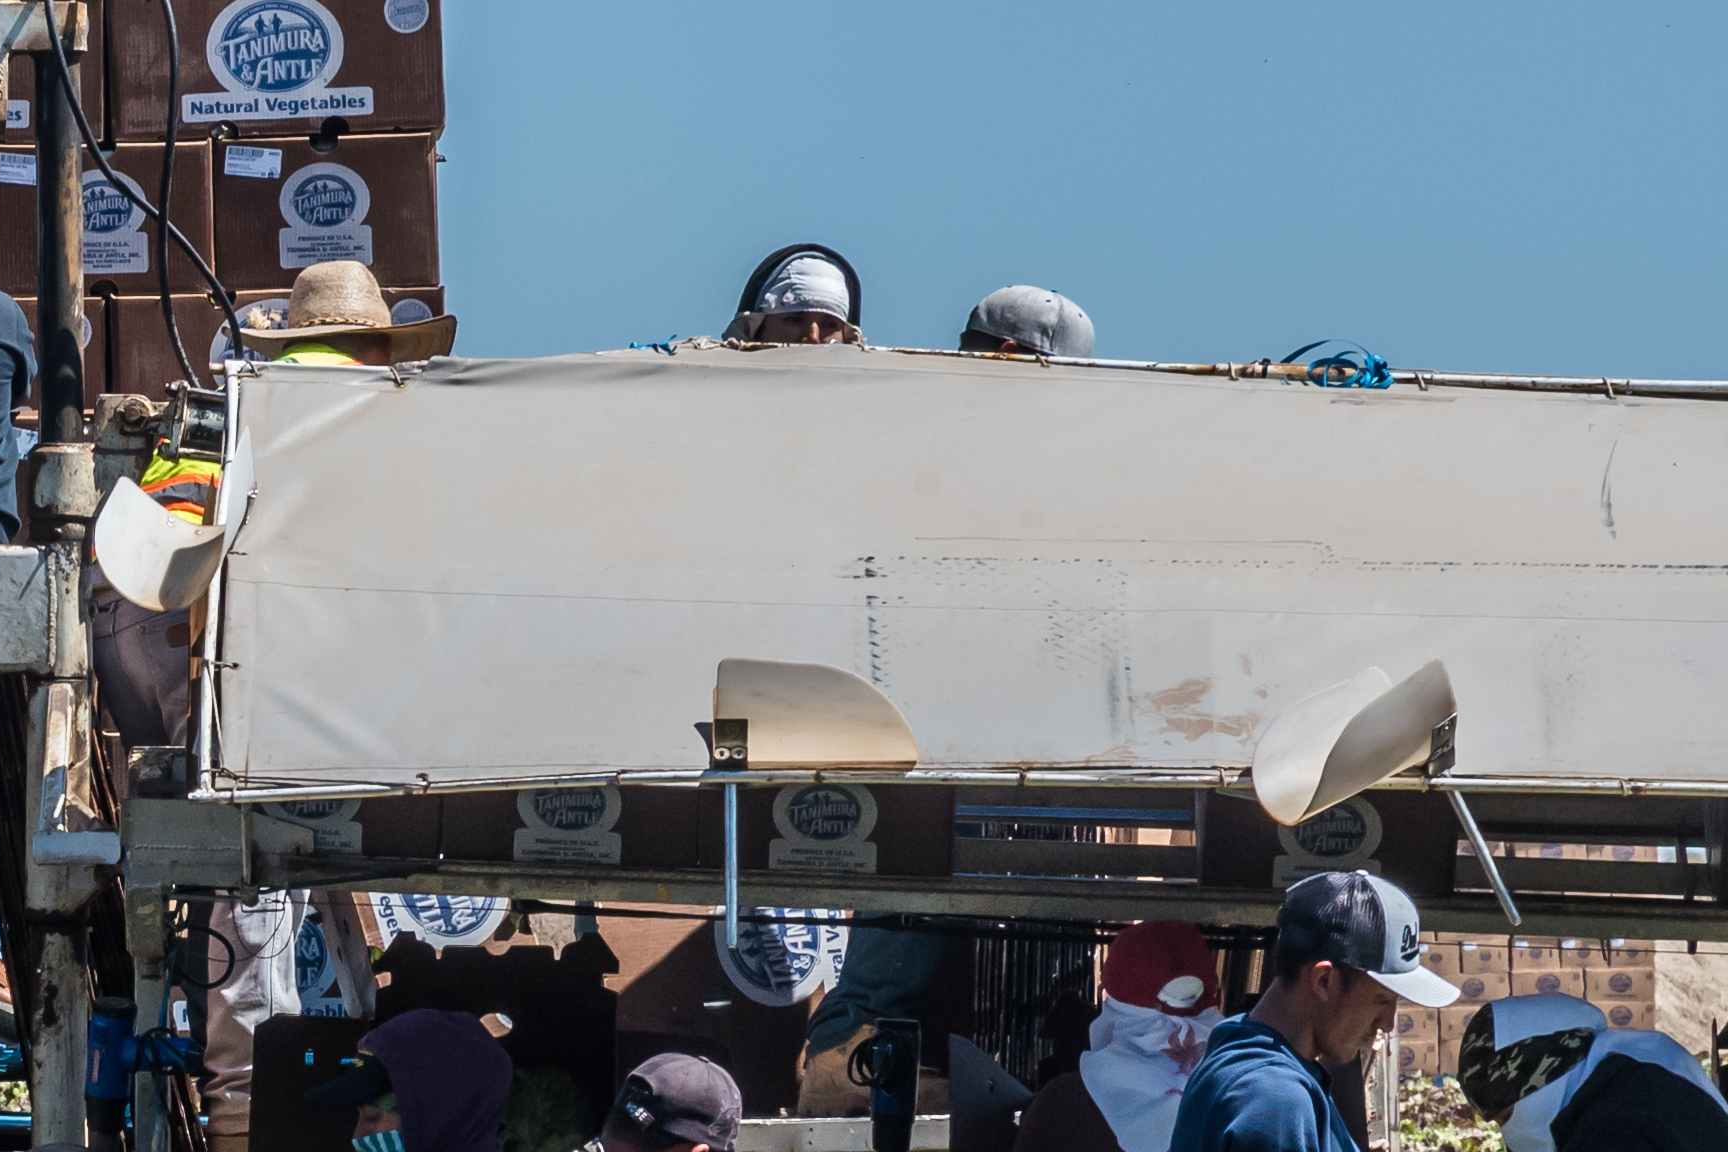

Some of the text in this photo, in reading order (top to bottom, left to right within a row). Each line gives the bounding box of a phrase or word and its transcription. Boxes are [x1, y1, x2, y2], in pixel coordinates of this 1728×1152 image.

[215, 29, 325, 70] TANIMURA
[240, 57, 323, 91] & ANTLE
[190, 95, 366, 115] Natural Vegetables
[293, 192, 353, 214] TANIMURA
[88, 211, 129, 230] ANTLE
[310, 206, 352, 226] ANTLE
[786, 803, 857, 824] TANIMURA
[792, 955, 812, 970] &
